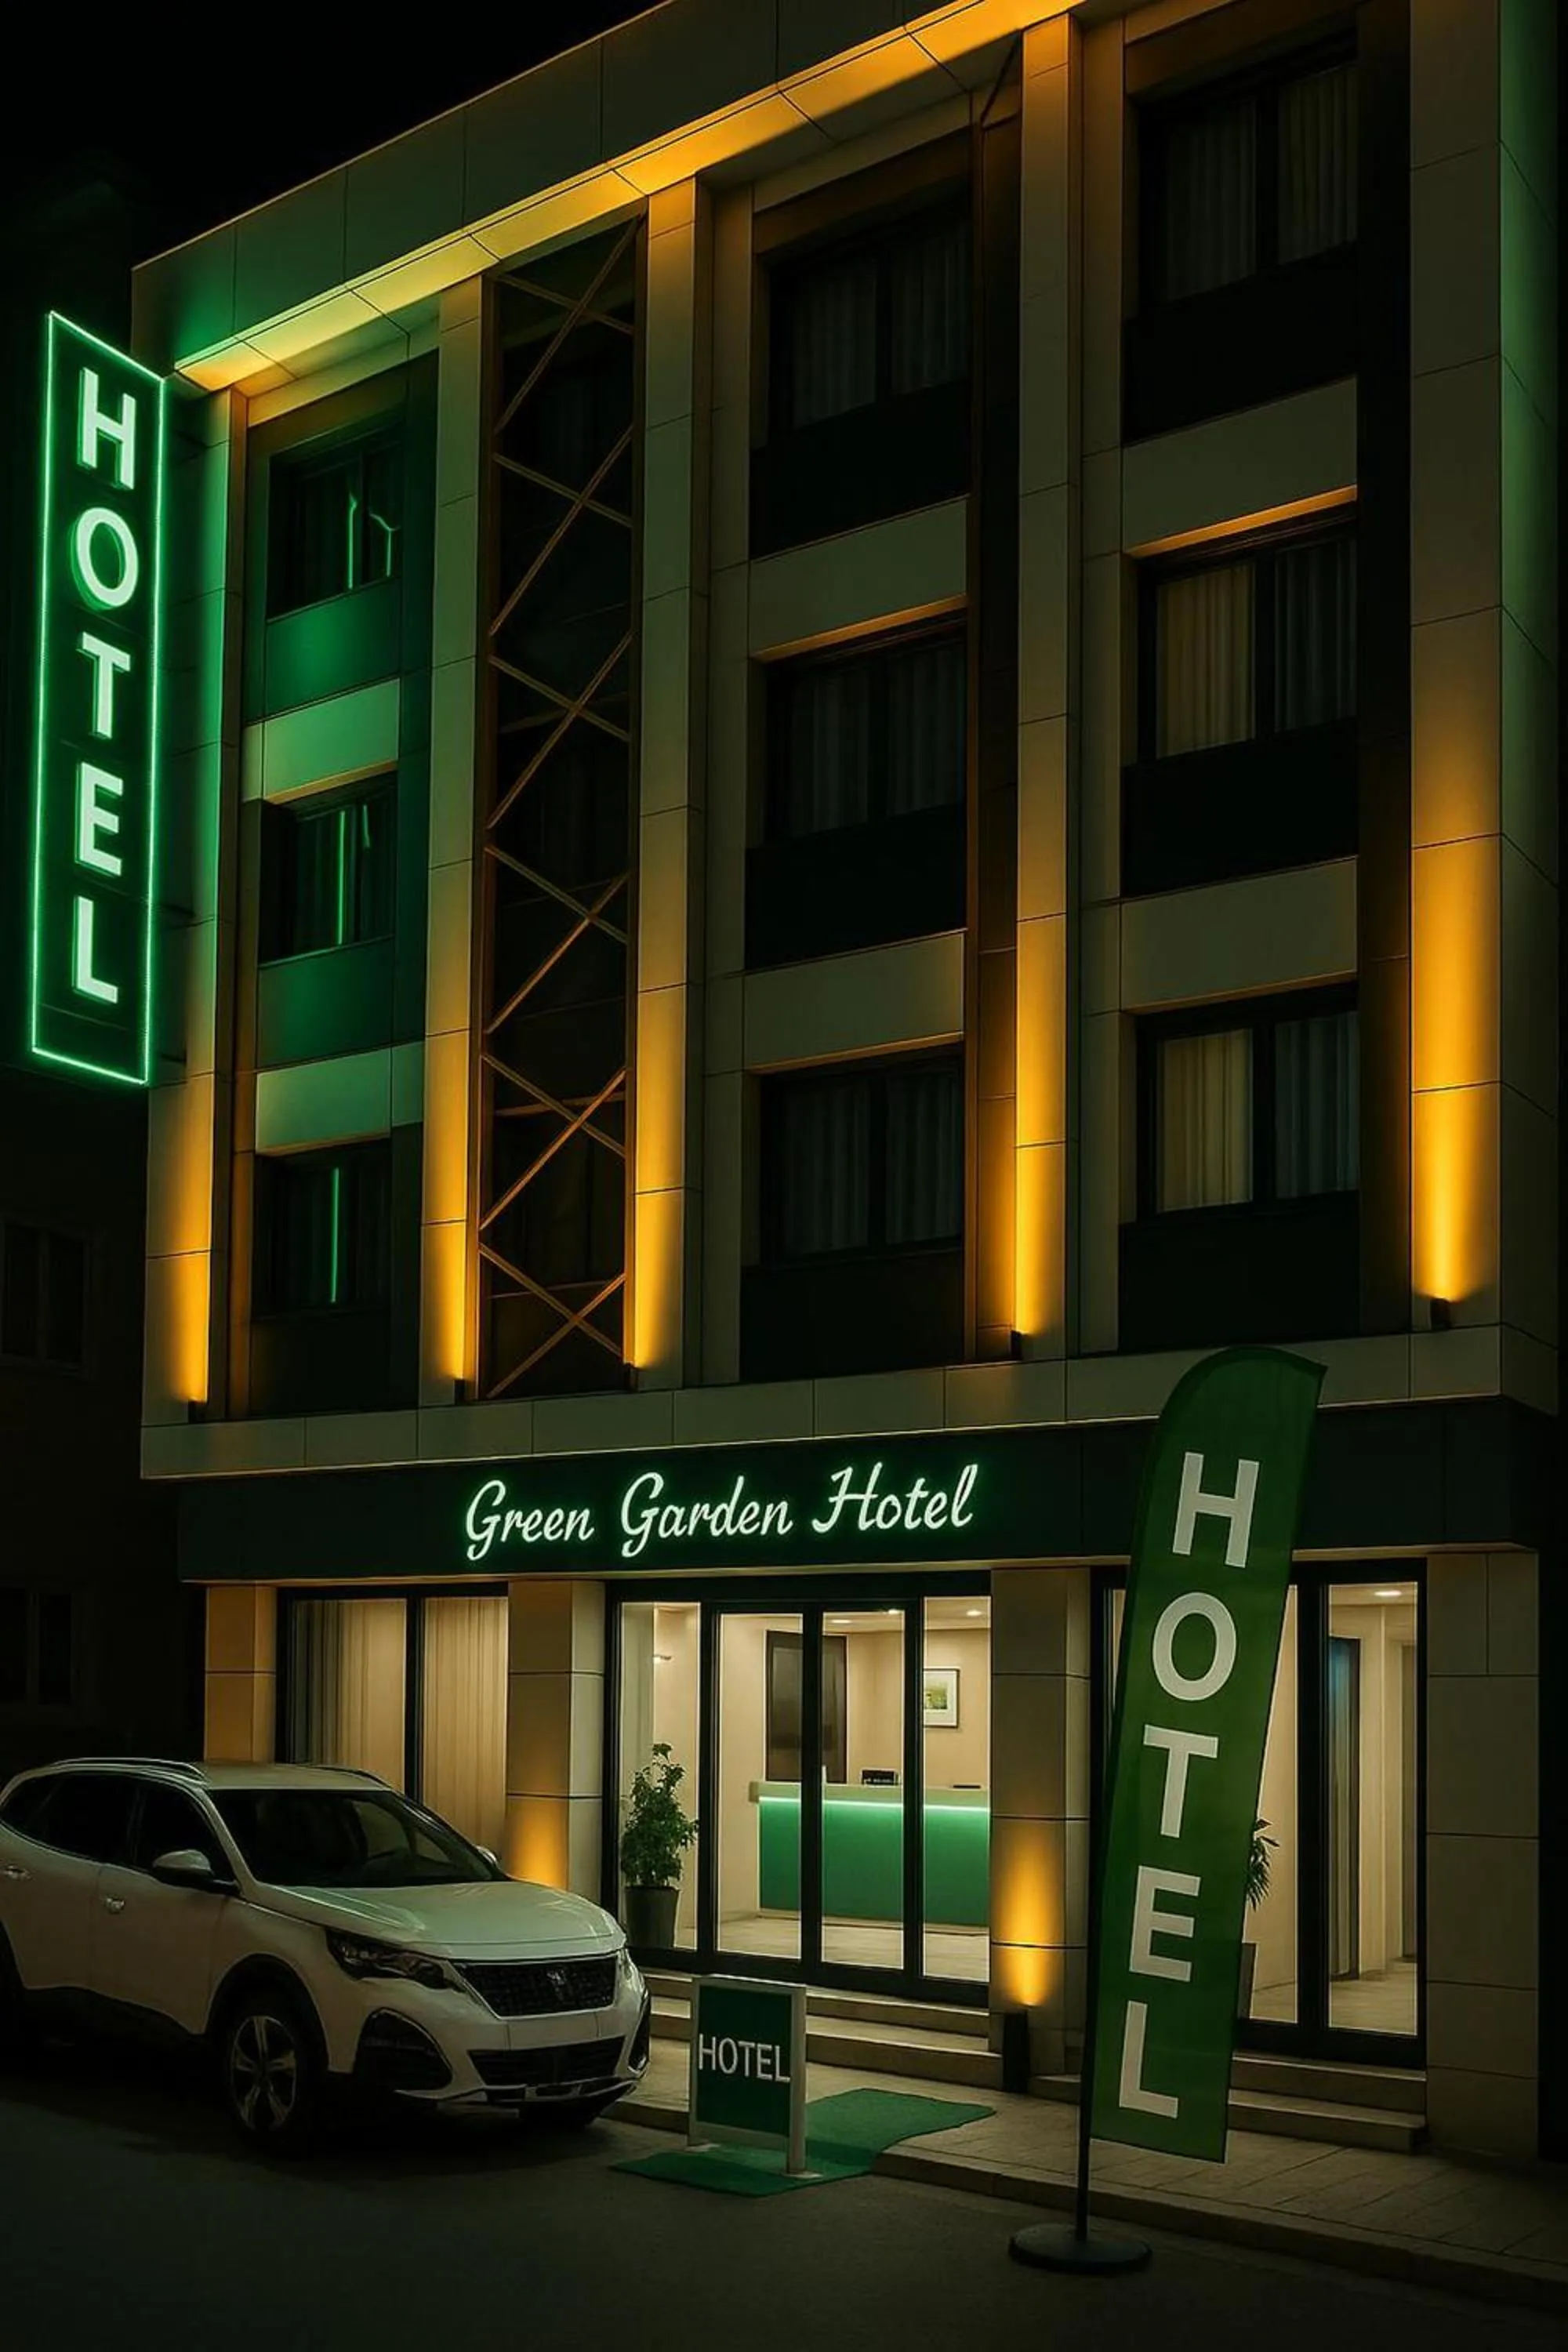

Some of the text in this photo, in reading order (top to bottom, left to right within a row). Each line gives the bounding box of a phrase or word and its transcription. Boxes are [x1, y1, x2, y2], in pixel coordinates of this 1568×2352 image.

[74, 365, 139, 1004] HOTEL
[466, 1461, 979, 1561] Green Garden Hotel
[1118, 1451, 1259, 2119] HOTEL
[698, 2033, 791, 2083] HOTEL
